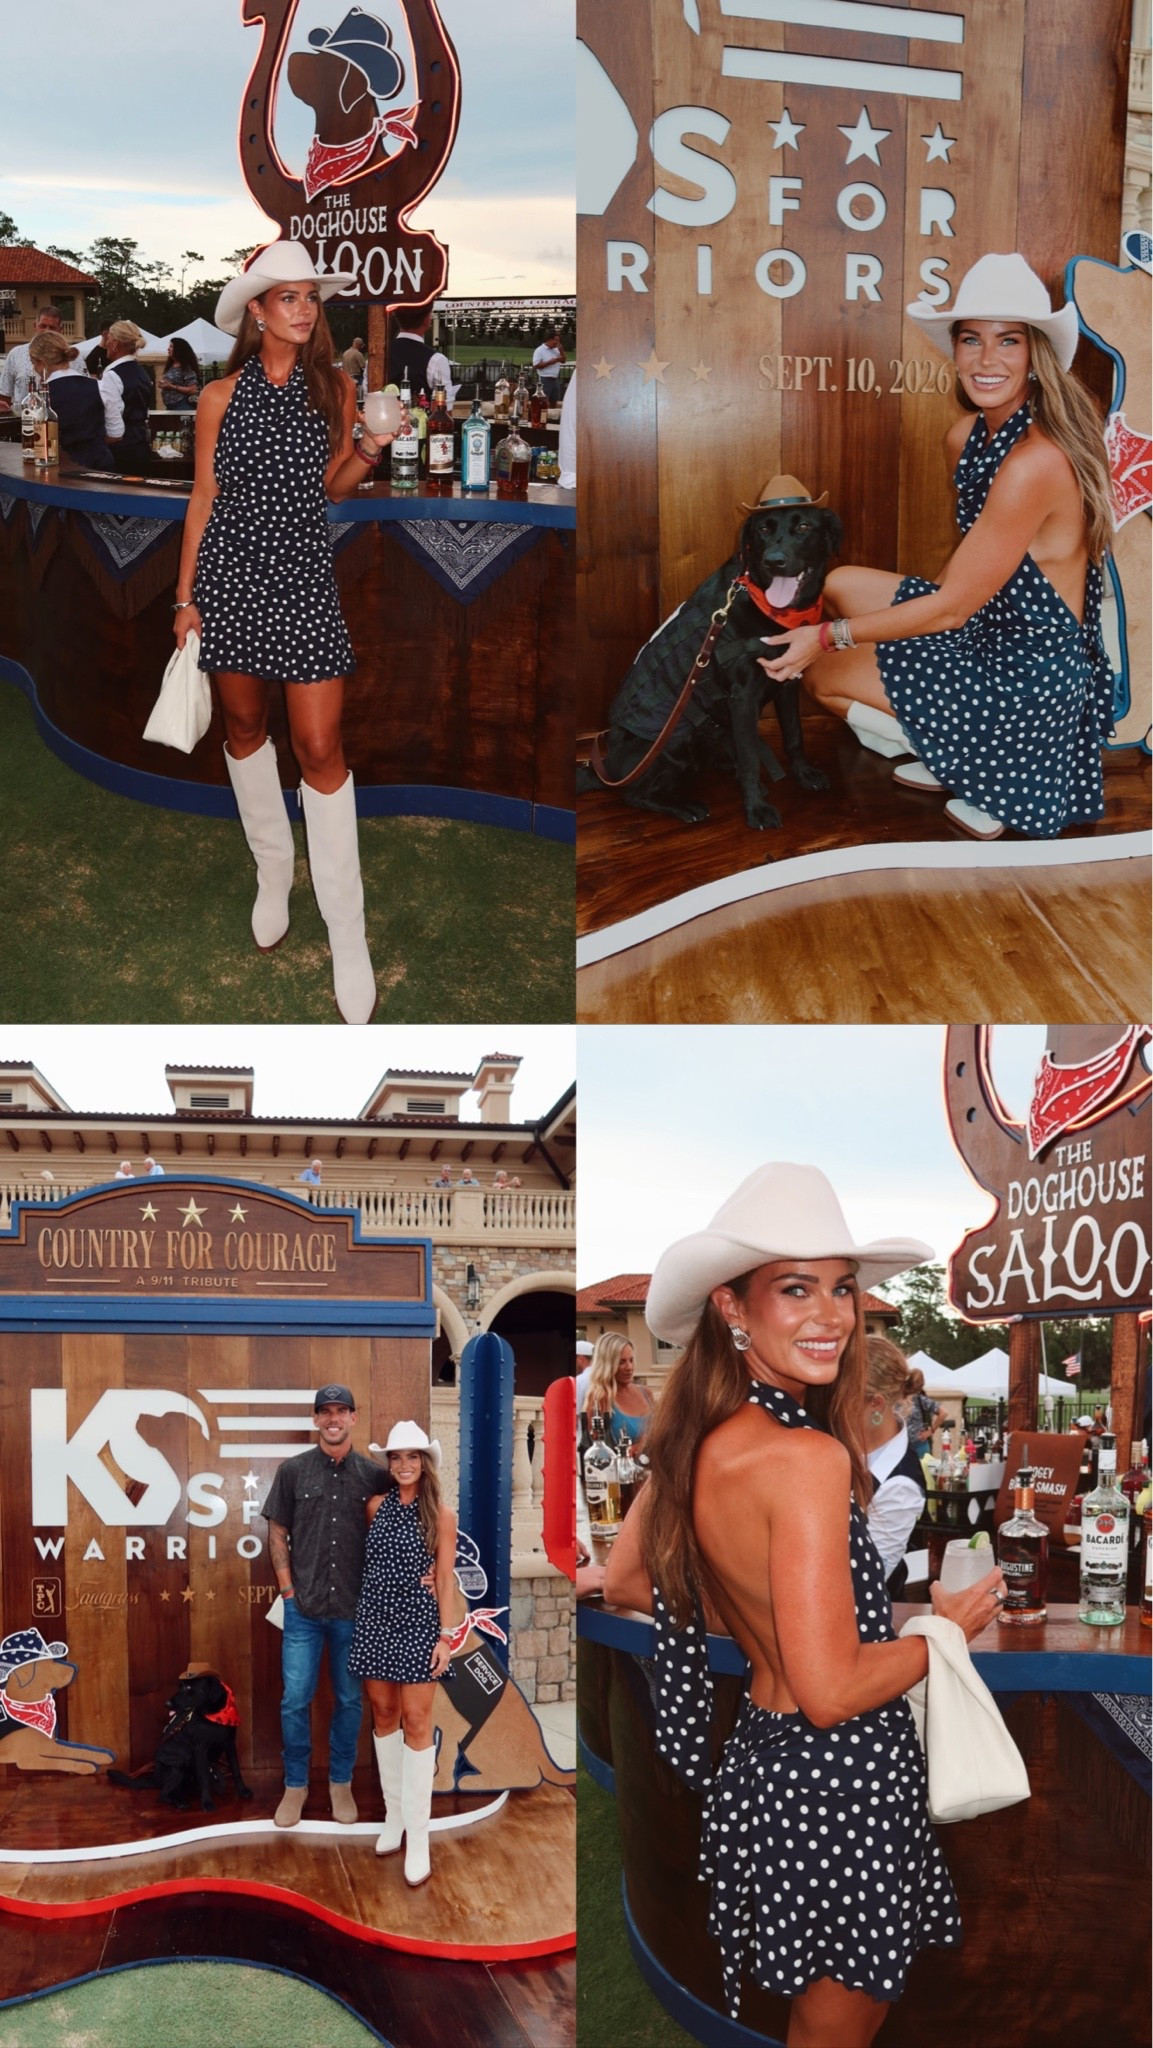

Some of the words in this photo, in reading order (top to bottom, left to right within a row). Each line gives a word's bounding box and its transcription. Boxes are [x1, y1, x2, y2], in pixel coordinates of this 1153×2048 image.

[324, 193, 350, 209] THE
[769, 176, 956, 237] FOR
[290, 205, 387, 241] DOGHOUSE
[314, 239, 424, 297] LOON
[445, 301, 497, 309] COUNTRY
[757, 354, 838, 392] SEPT.
[845, 357, 882, 400] 10,
[889, 359, 953, 395] 2026
[1055, 1140, 1092, 1167] THE
[1007, 1155, 1146, 1219] DOGHOUSE
[38, 1227, 157, 1270] COUNTRY
[166, 1230, 214, 1270] FOR
[223, 1231, 337, 1273] COURAGE
[967, 1215, 1152, 1309] SALOO
[136, 1276, 145, 1286] A
[151, 1275, 174, 1287] 9/11
[183, 1276, 239, 1288] TRIBUTE
[1035, 1481, 1067, 1496] SMASH
[34, 1535, 291, 1561] WARRIO
[36, 1584, 45, 1610] TPC
[65, 1581, 139, 1612] Sawgrass
[474, 1656, 498, 1685] SERVICE
[474, 1668, 487, 1683] DOG
